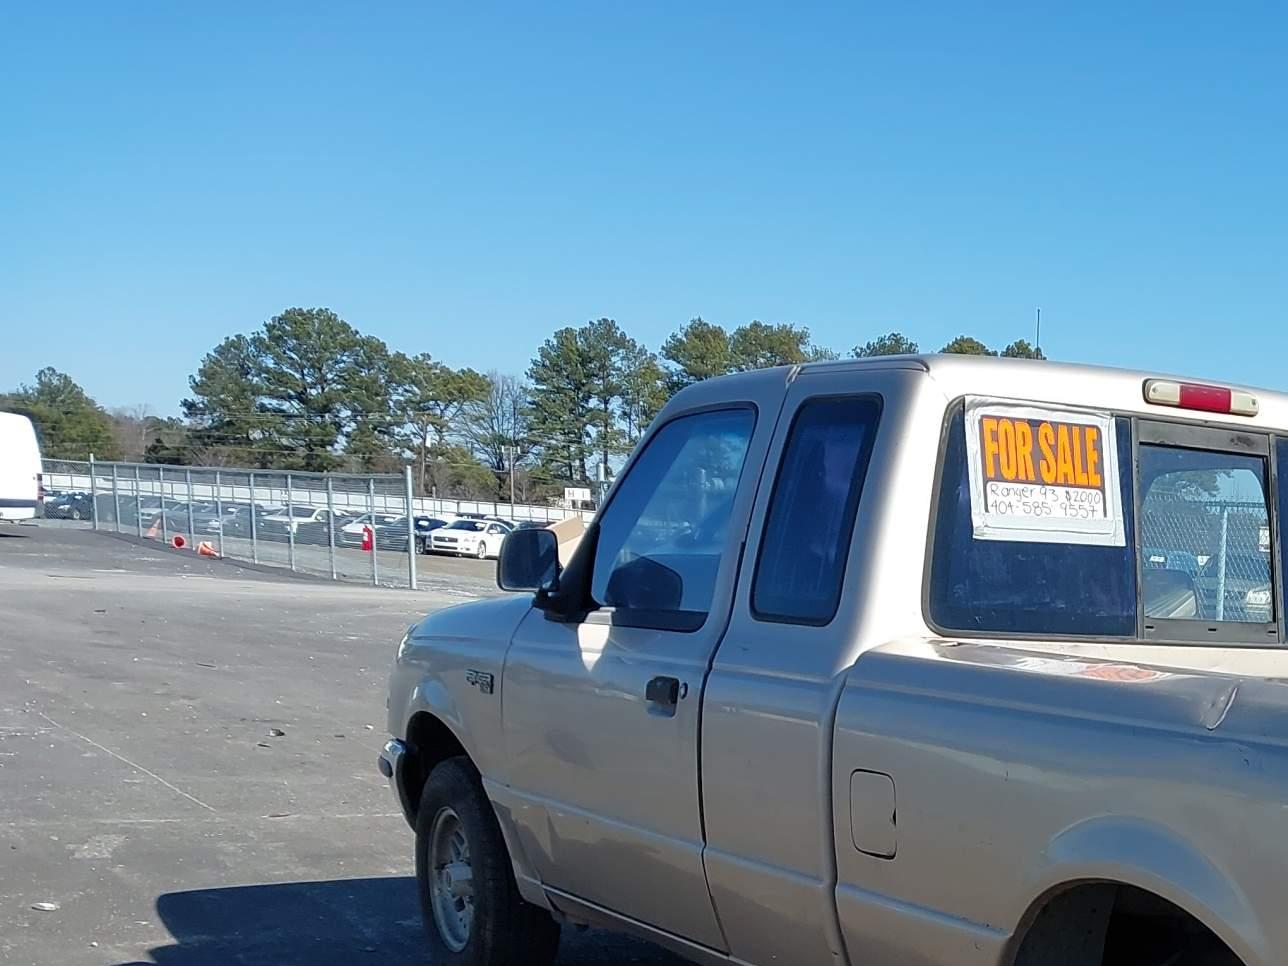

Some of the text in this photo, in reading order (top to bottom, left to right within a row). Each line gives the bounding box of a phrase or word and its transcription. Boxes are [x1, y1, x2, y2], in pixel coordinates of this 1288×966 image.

[982, 418, 1101, 488] FOR SALE
[990, 483, 1101, 504] Ranger 93 $2000
